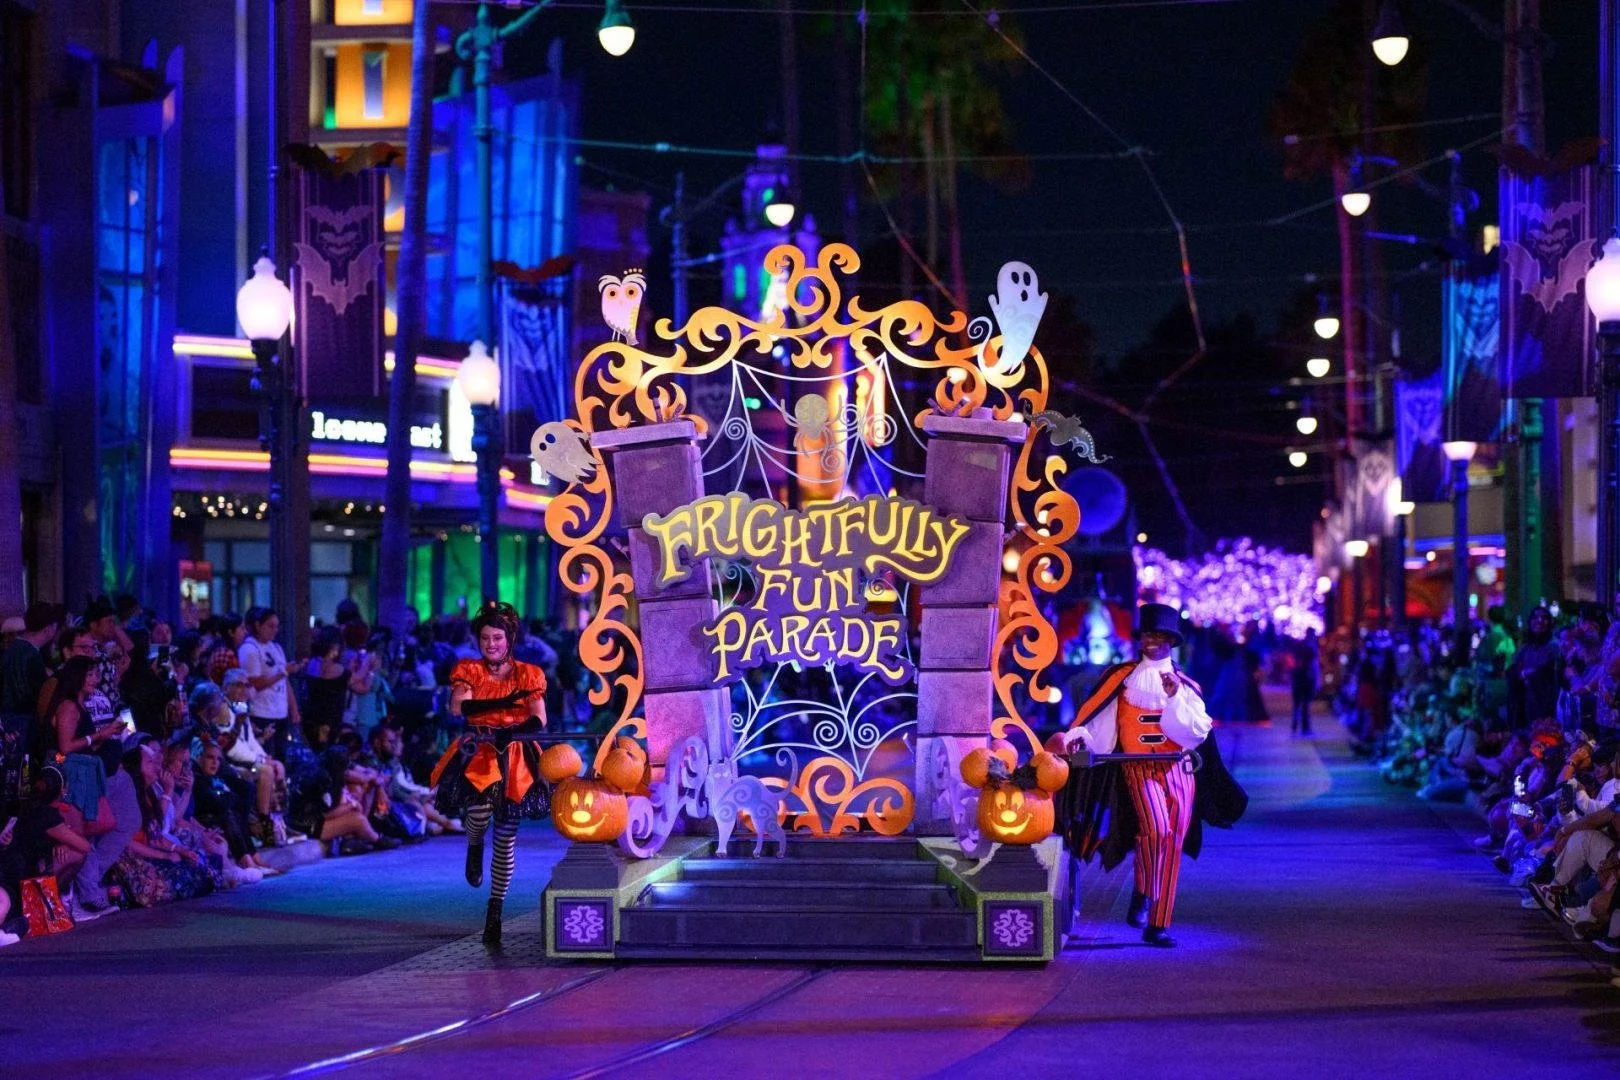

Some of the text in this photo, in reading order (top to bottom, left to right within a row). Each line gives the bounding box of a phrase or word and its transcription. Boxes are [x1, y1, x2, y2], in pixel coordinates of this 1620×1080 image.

[648, 497, 971, 583] FRIGHTFULLY
[751, 567, 859, 612] FUN
[703, 611, 904, 682] PARADE
